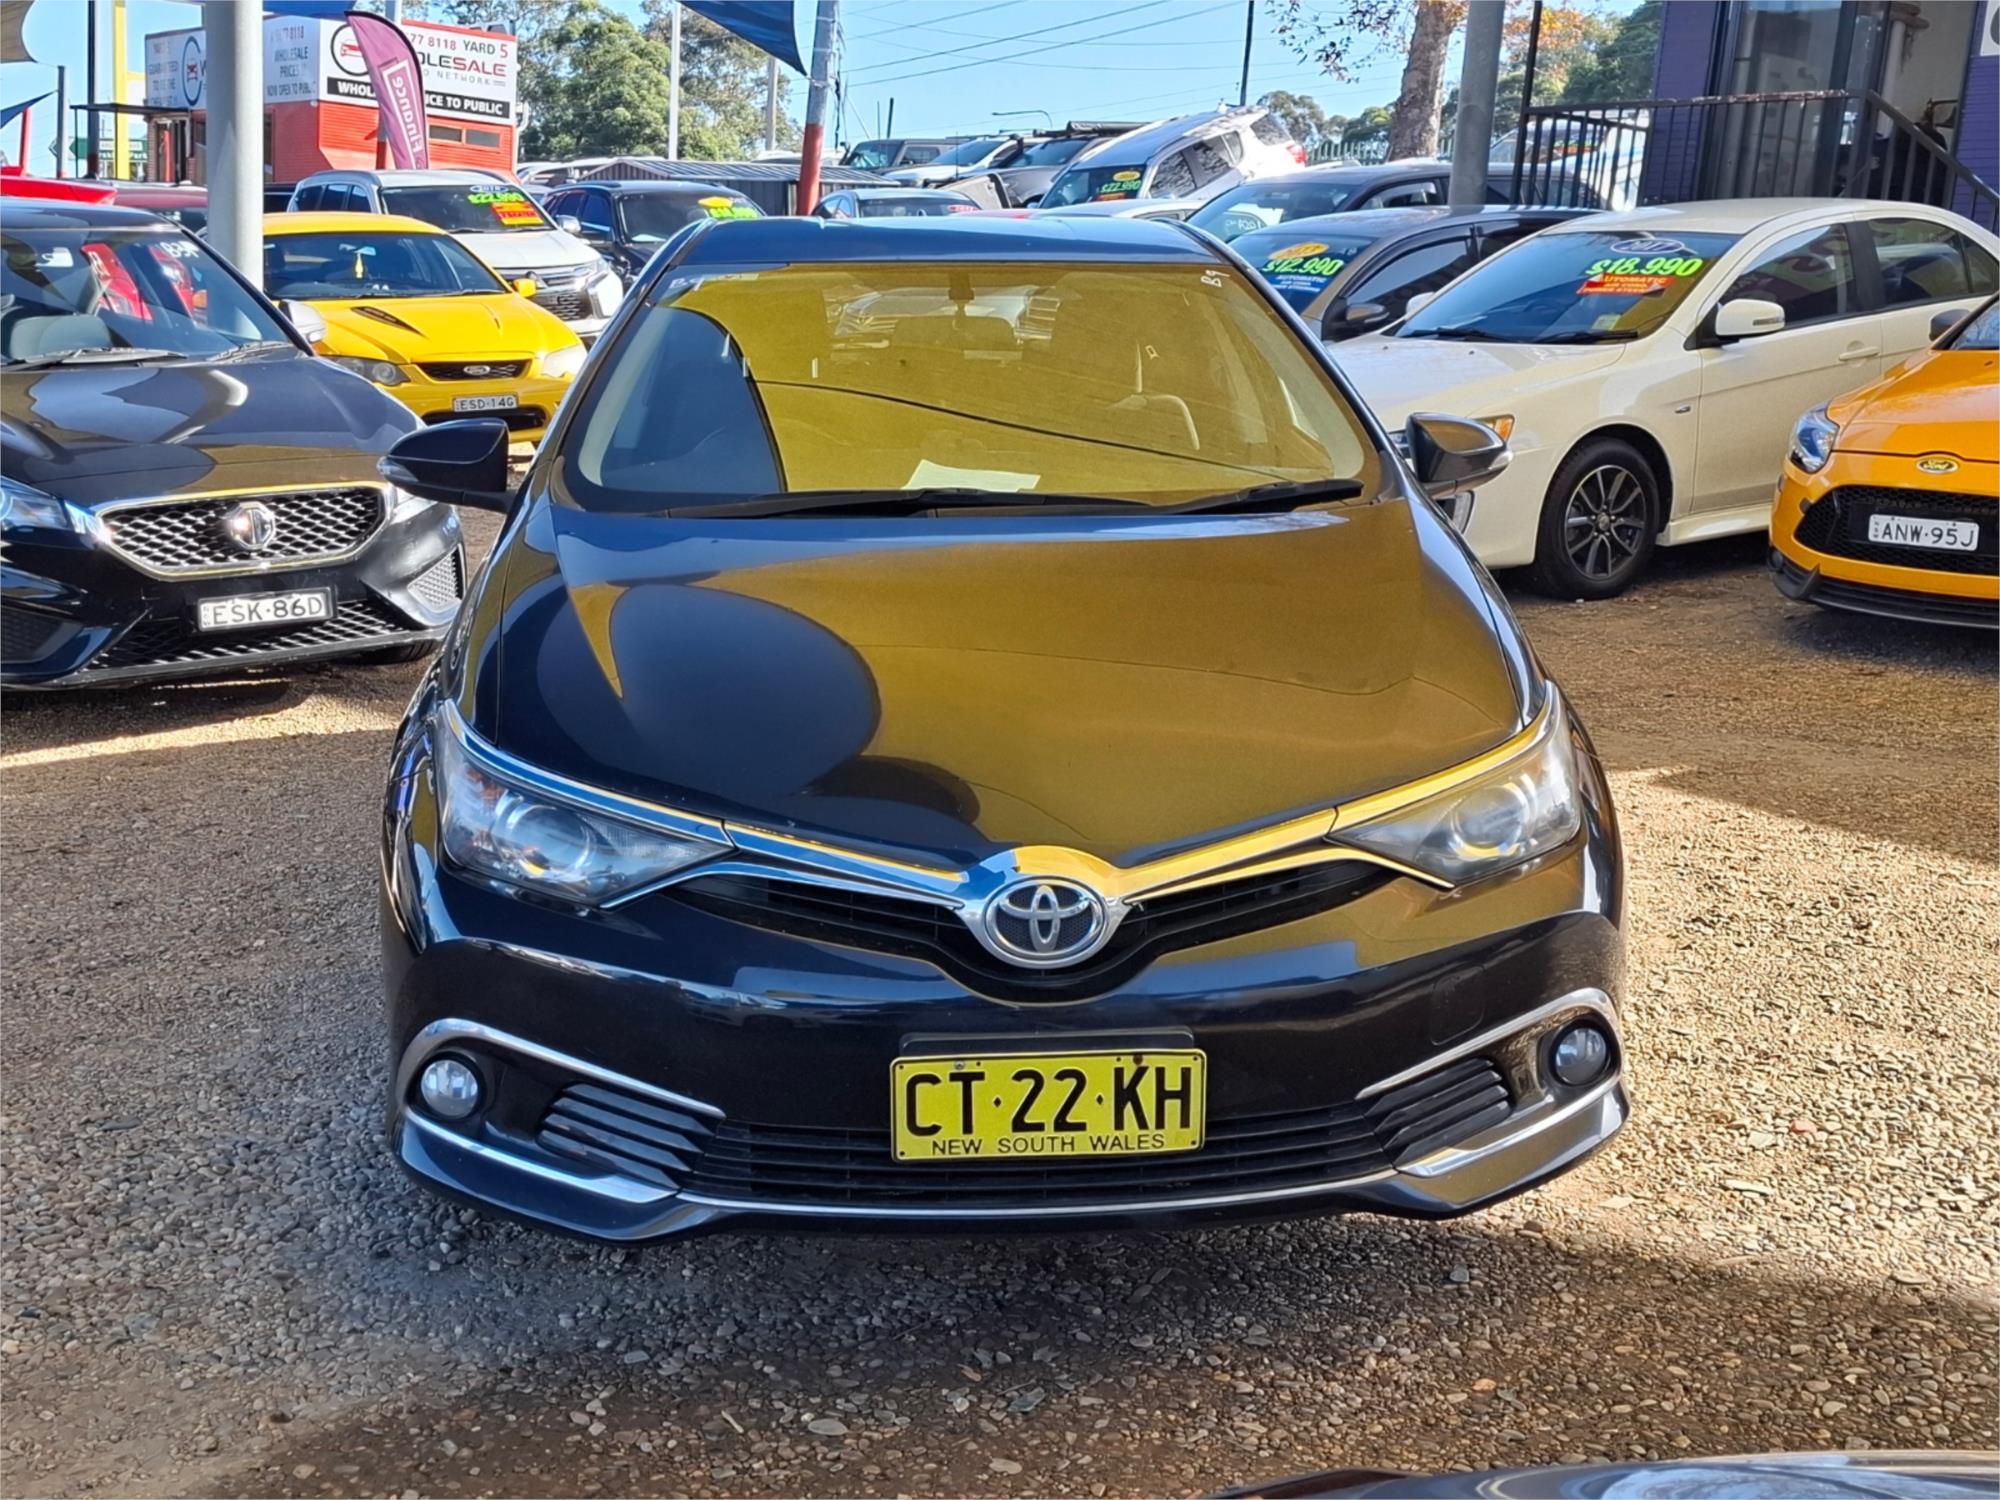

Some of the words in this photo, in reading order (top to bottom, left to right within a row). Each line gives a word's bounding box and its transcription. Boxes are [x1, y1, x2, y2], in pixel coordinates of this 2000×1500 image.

[428, 36, 457, 51] 8118
[463, 39, 496, 55] YARD
[499, 43, 509, 58] 5
[437, 70, 491, 85] NETWORK
[446, 96, 461, 109] TO
[464, 99, 503, 115] PUBLIC
[1604, 274, 1667, 284] UTOMATIC
[931, 1138, 983, 1156] NEW
[997, 1135, 1075, 1153] SOUTH
[1089, 1133, 1165, 1151] WALES
